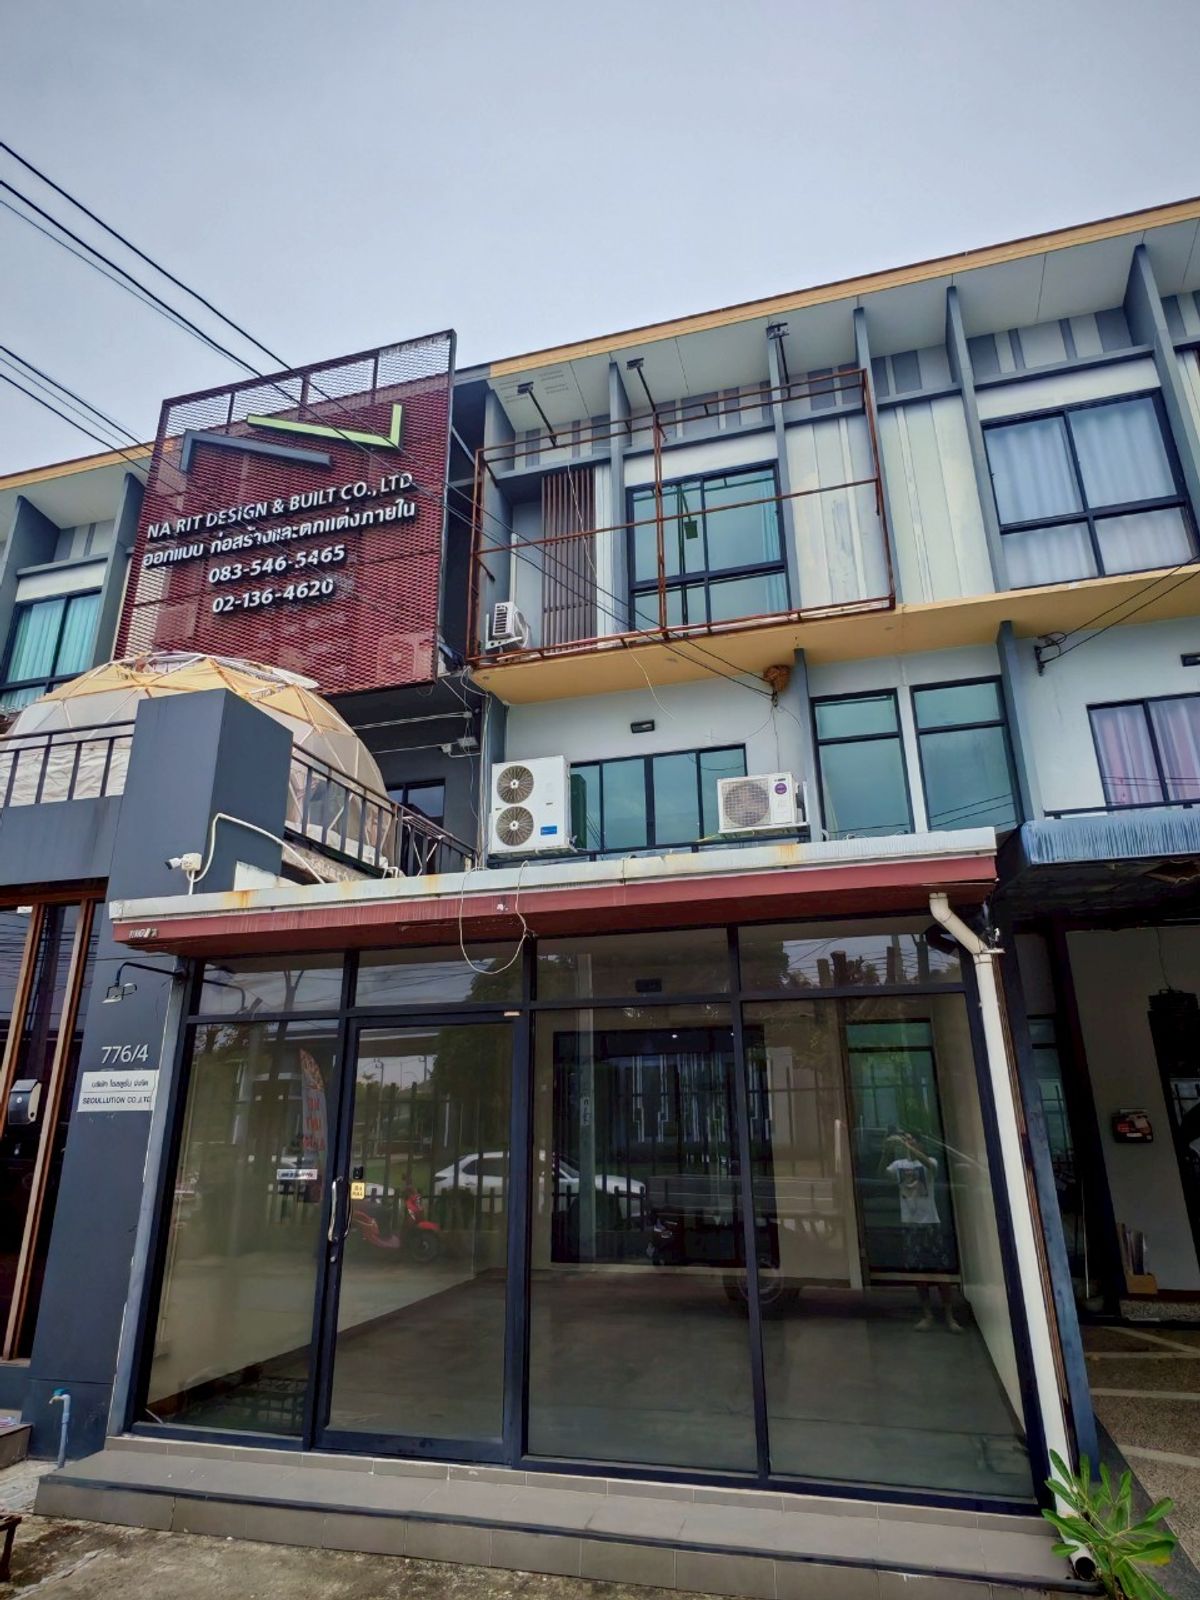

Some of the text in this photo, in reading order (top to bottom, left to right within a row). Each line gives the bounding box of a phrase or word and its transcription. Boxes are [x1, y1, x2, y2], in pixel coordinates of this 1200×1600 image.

[147, 522, 171, 539] NA
[176, 515, 203, 533] RIT
[206, 502, 268, 526] DESIGN
[272, 499, 285, 513] &
[289, 487, 336, 511] BUILT
[143, 544, 204, 567] ออกแบบ
[208, 545, 346, 584] 083-546-5465
[212, 579, 335, 614] 02-136-4620
[101, 1043, 149, 1064] 776/4
